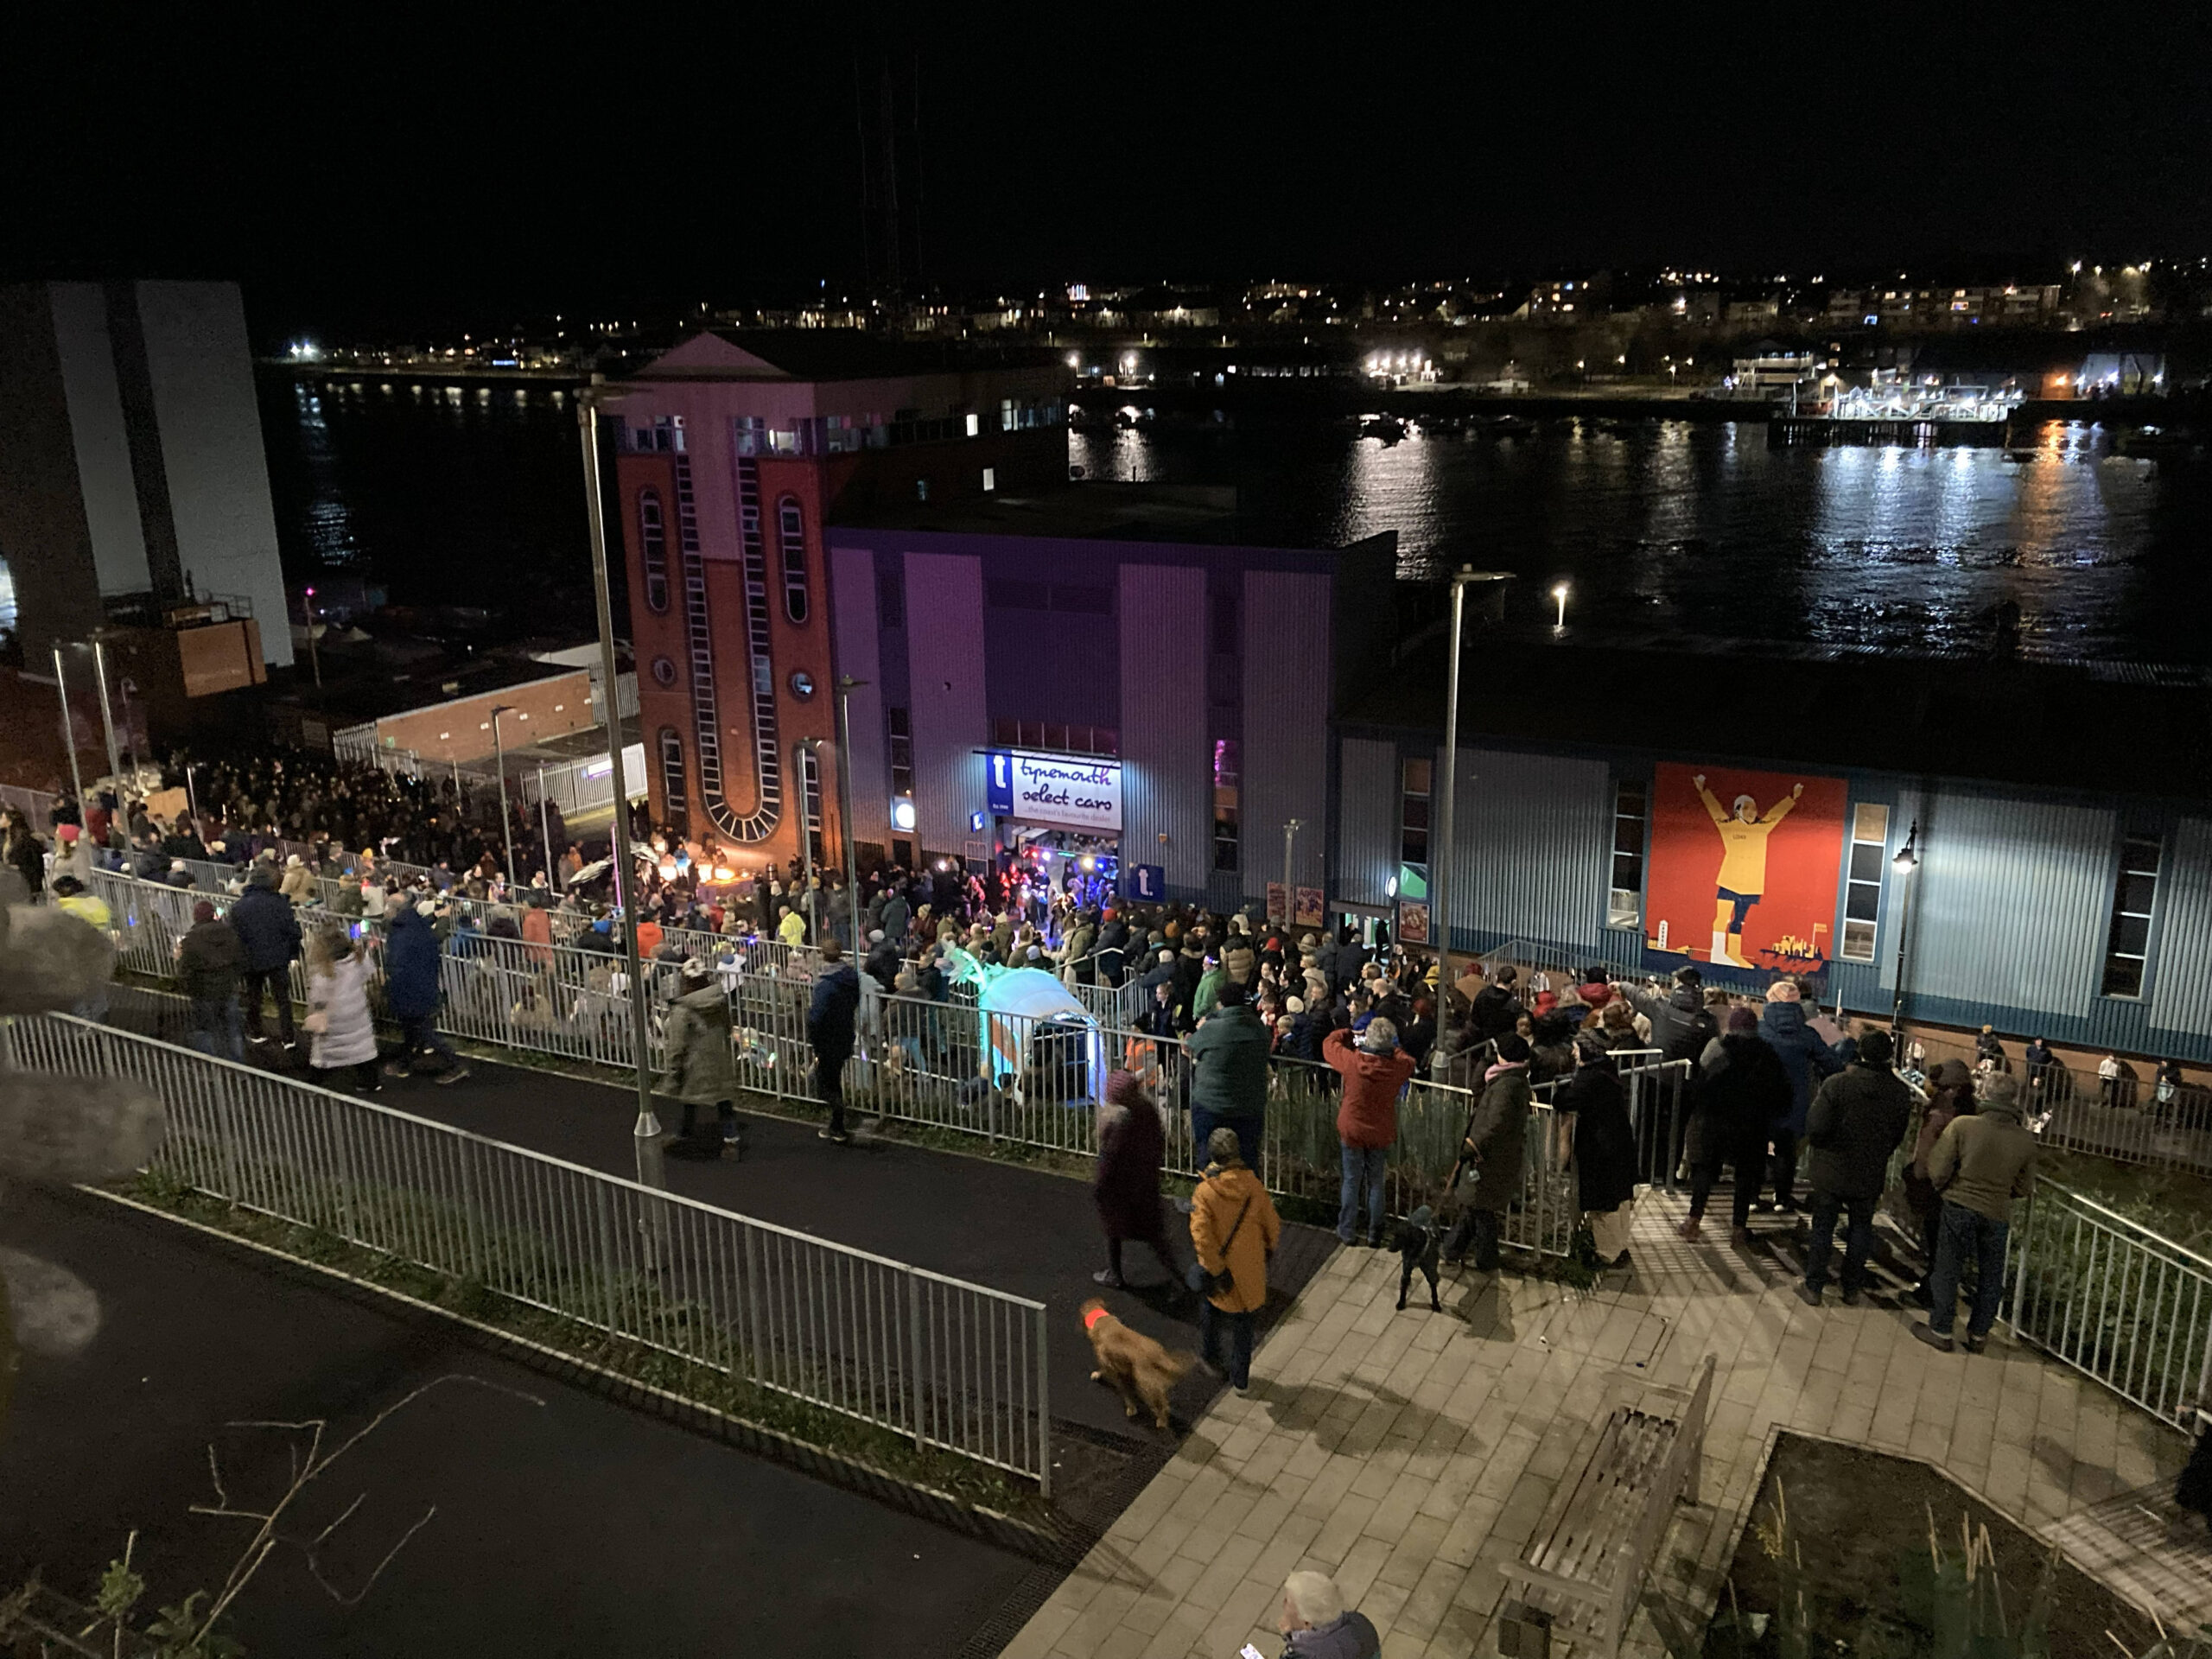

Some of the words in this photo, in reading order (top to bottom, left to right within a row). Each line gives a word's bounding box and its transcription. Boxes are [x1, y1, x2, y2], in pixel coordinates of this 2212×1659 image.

[1020, 758, 1111, 785] tynemouth
[1021, 783, 1070, 805] select
[1074, 798, 1112, 811] cars
